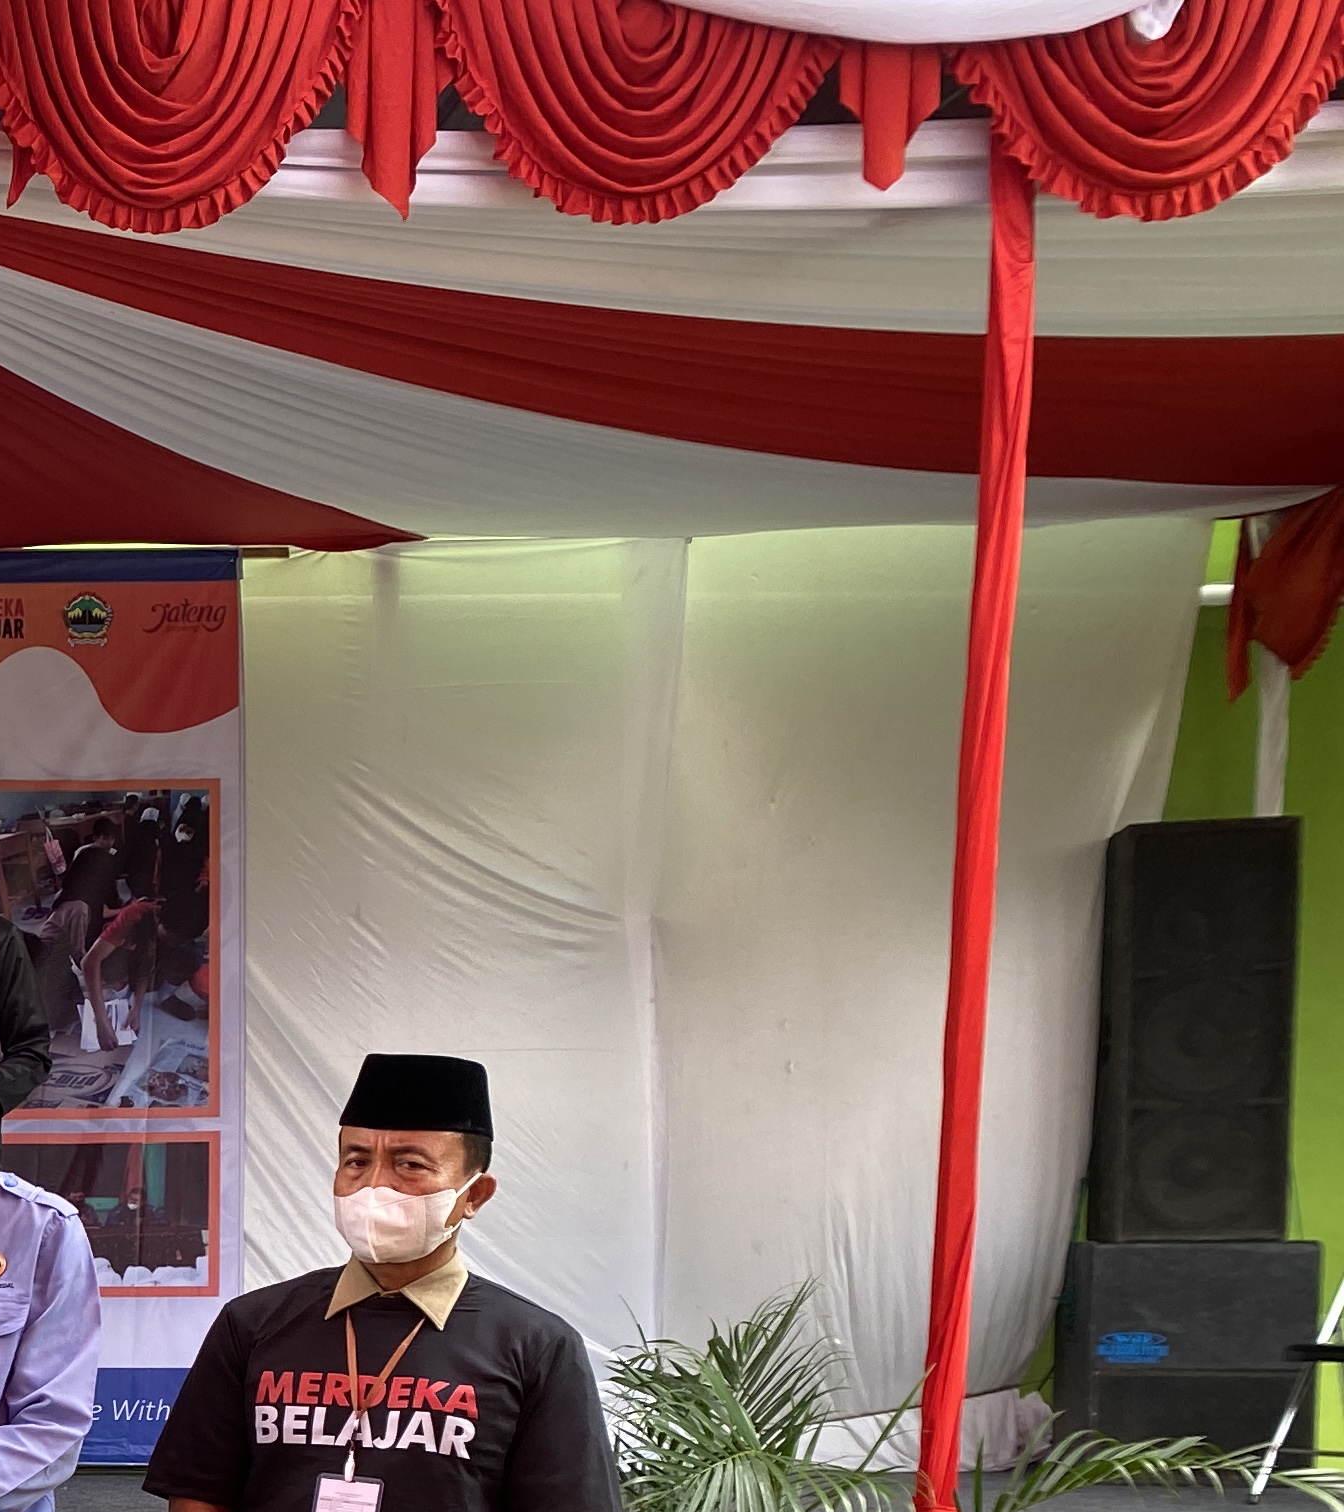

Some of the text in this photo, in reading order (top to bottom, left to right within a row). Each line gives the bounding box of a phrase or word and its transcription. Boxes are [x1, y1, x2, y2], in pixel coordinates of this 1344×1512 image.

[142, 598, 227, 633] Jateng
[113, 1399, 171, 1421] With
[255, 1371, 479, 1419] MERDEKA
[255, 1406, 475, 1459] BELAJAR
